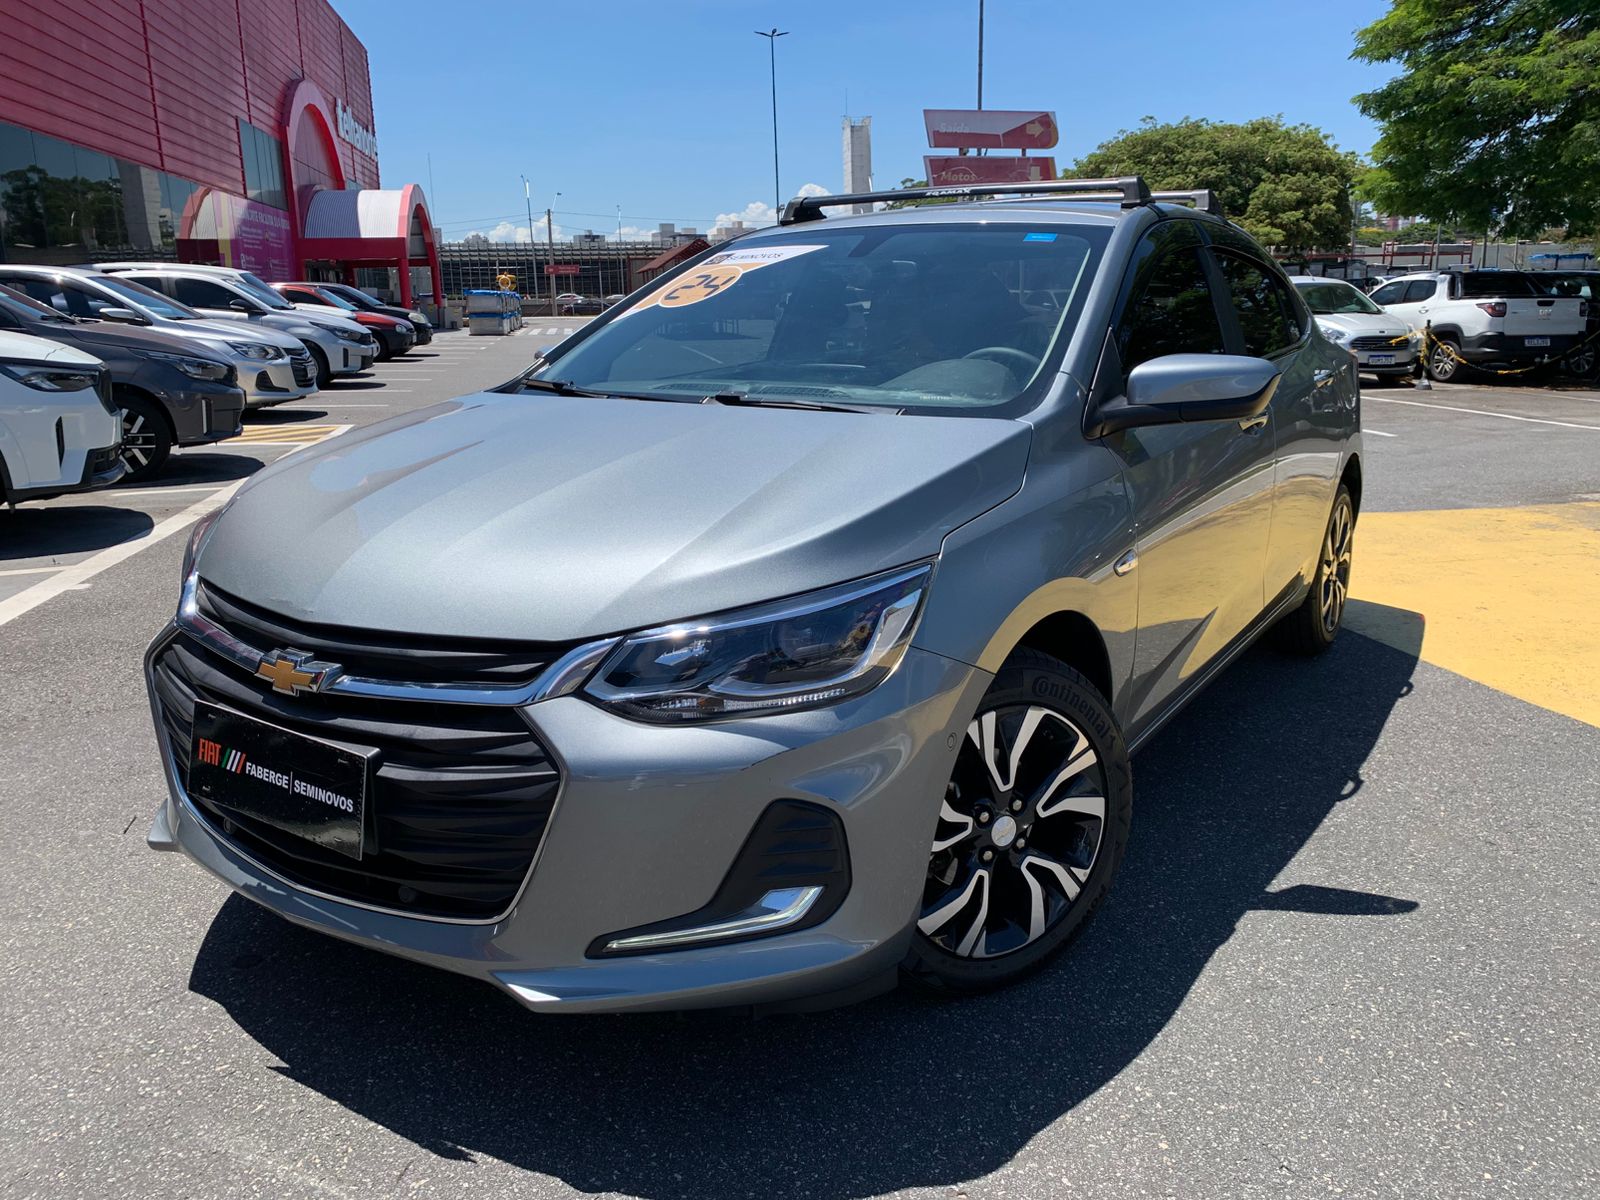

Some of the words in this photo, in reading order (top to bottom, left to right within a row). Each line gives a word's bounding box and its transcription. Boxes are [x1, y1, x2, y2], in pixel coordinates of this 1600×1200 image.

[940, 171, 976, 182] Motos
[199, 738, 222, 766] FIAT
[245, 761, 290, 789] FABERGE
[293, 779, 354, 813] SEMINOVOS
